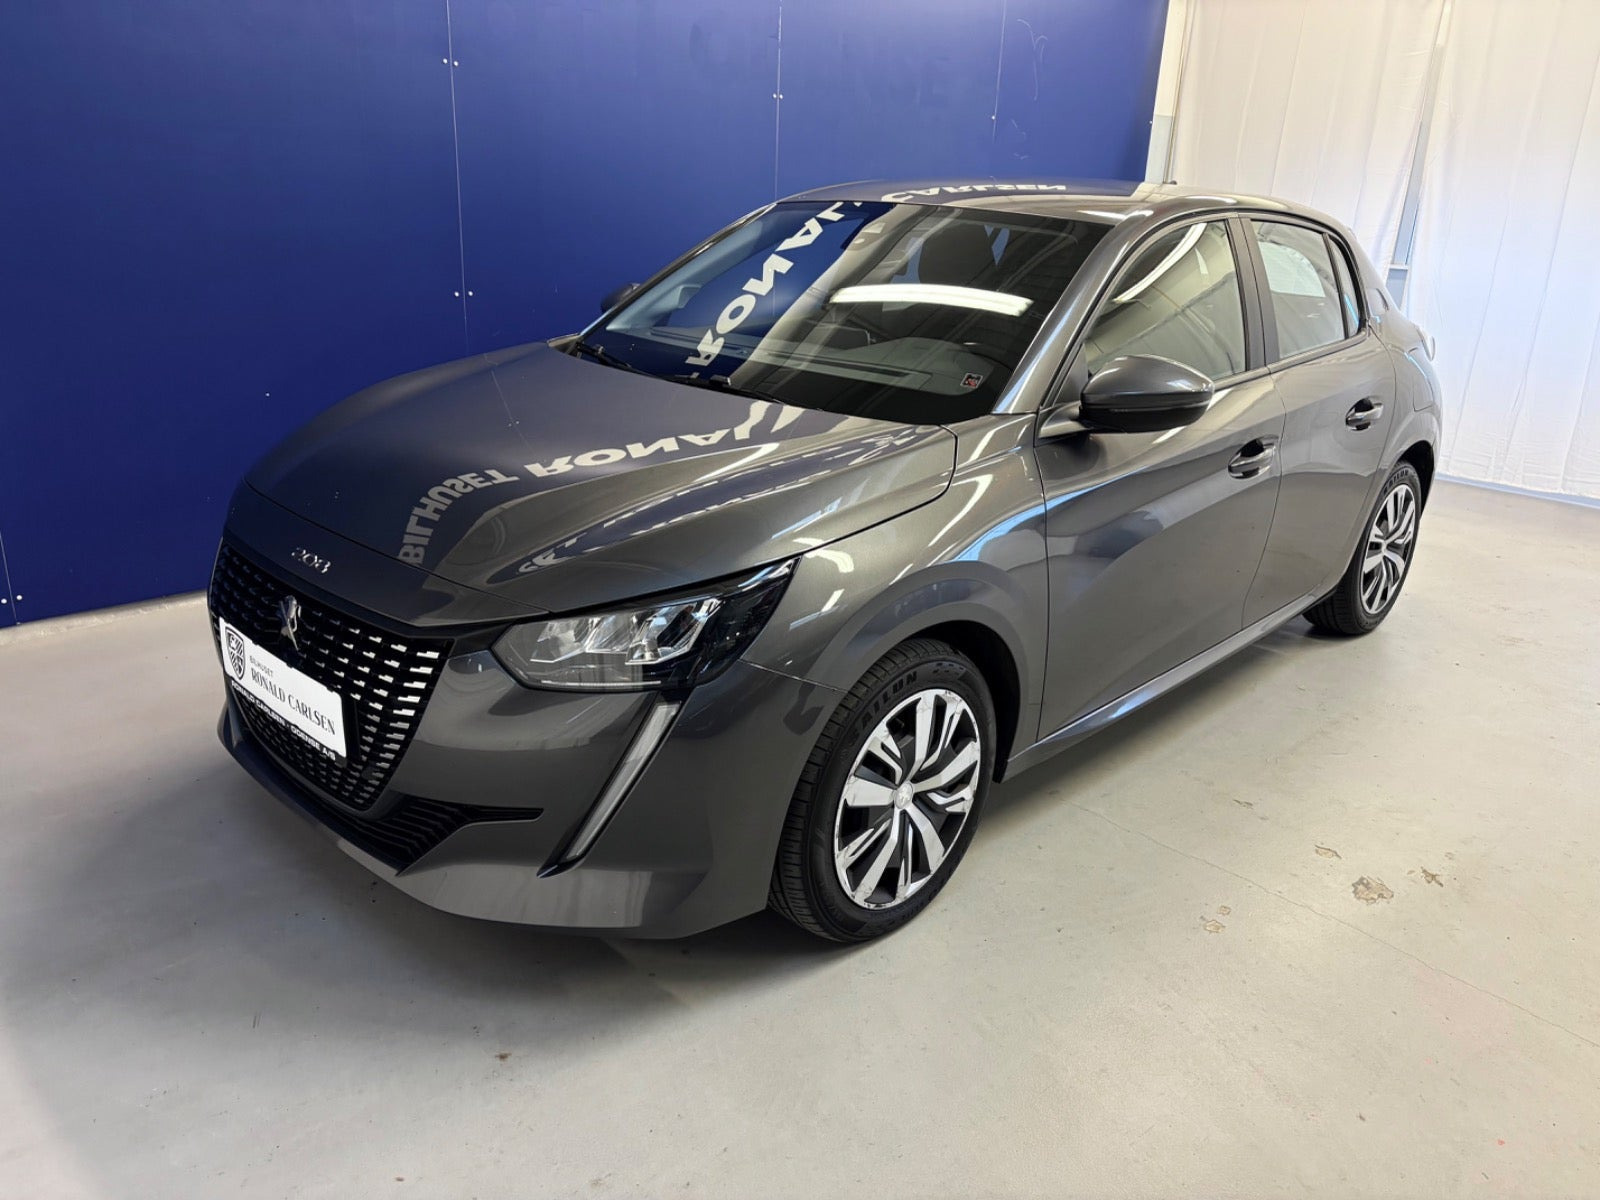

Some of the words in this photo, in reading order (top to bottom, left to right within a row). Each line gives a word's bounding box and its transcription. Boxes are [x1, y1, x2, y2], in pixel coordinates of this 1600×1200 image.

[291, 547, 331, 574] 208
[250, 667, 286, 703] RONALD
[288, 694, 336, 736] CARLSEN
